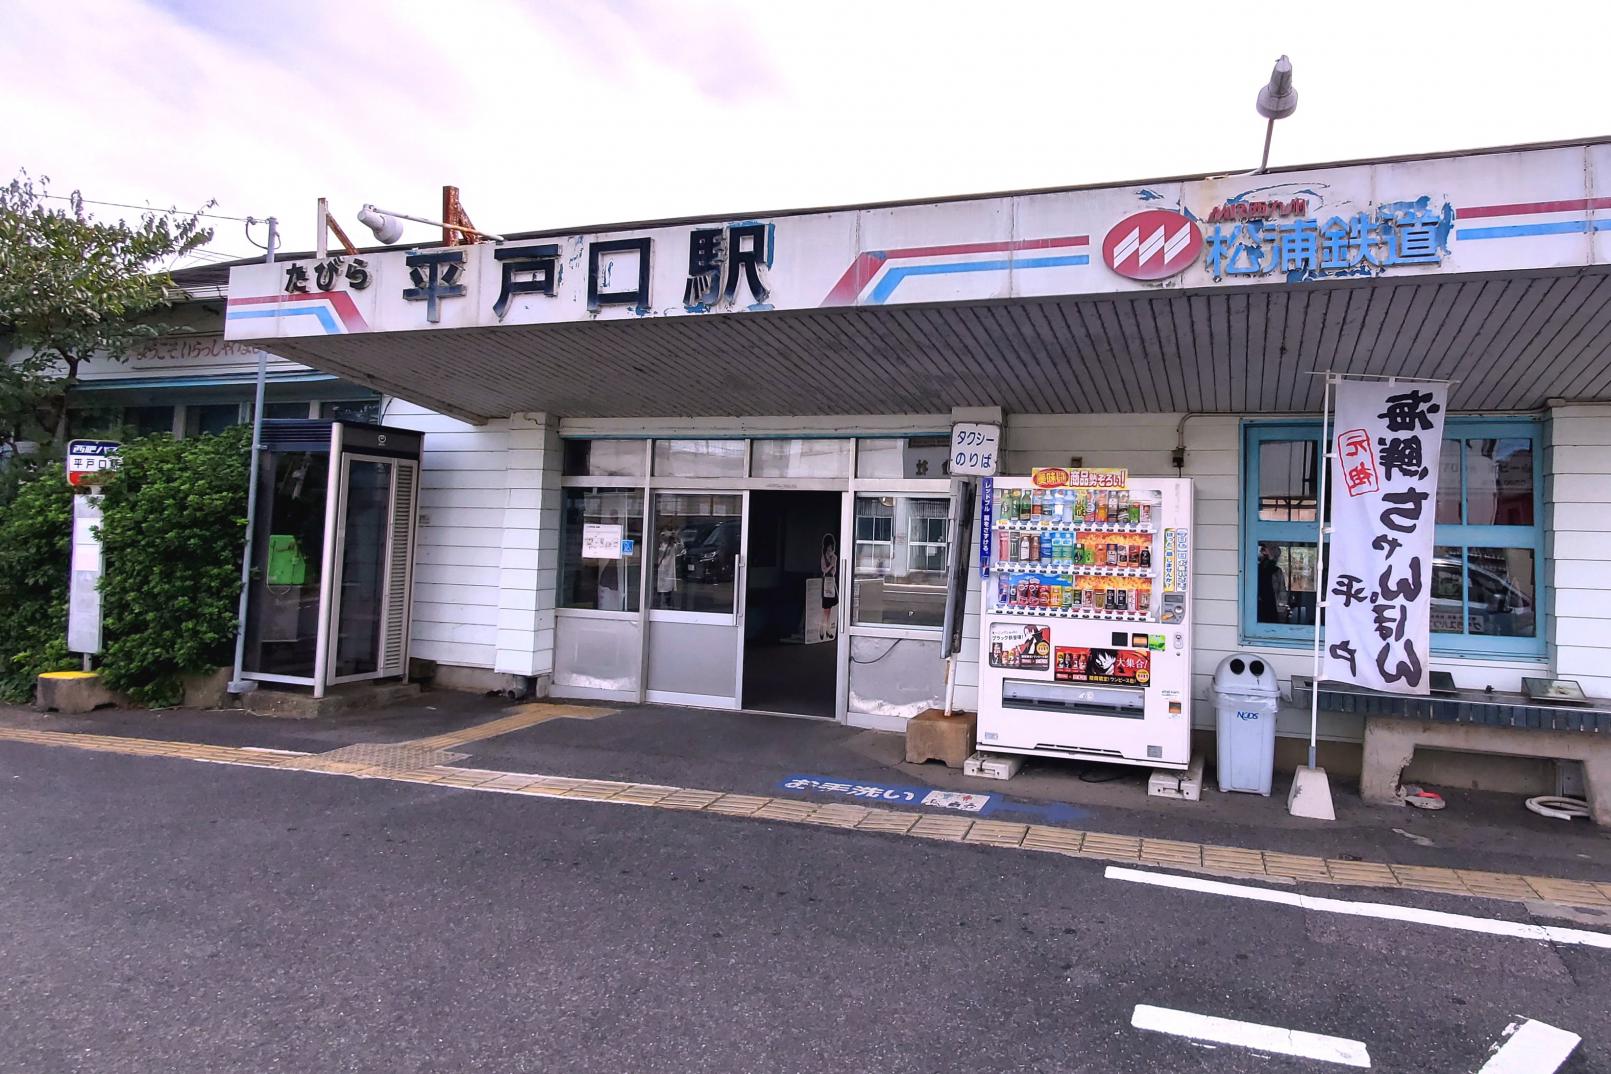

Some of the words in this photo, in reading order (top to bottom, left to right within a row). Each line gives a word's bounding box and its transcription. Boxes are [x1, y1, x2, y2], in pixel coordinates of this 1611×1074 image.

[1205, 213, 1442, 279] 松浦鉄道
[285, 257, 373, 294] たびら
[402, 223, 771, 324] 平戸口駅
[957, 430, 995, 446] タクシー
[955, 452, 992, 469] のりば
[784, 778, 915, 801] お手洗い
